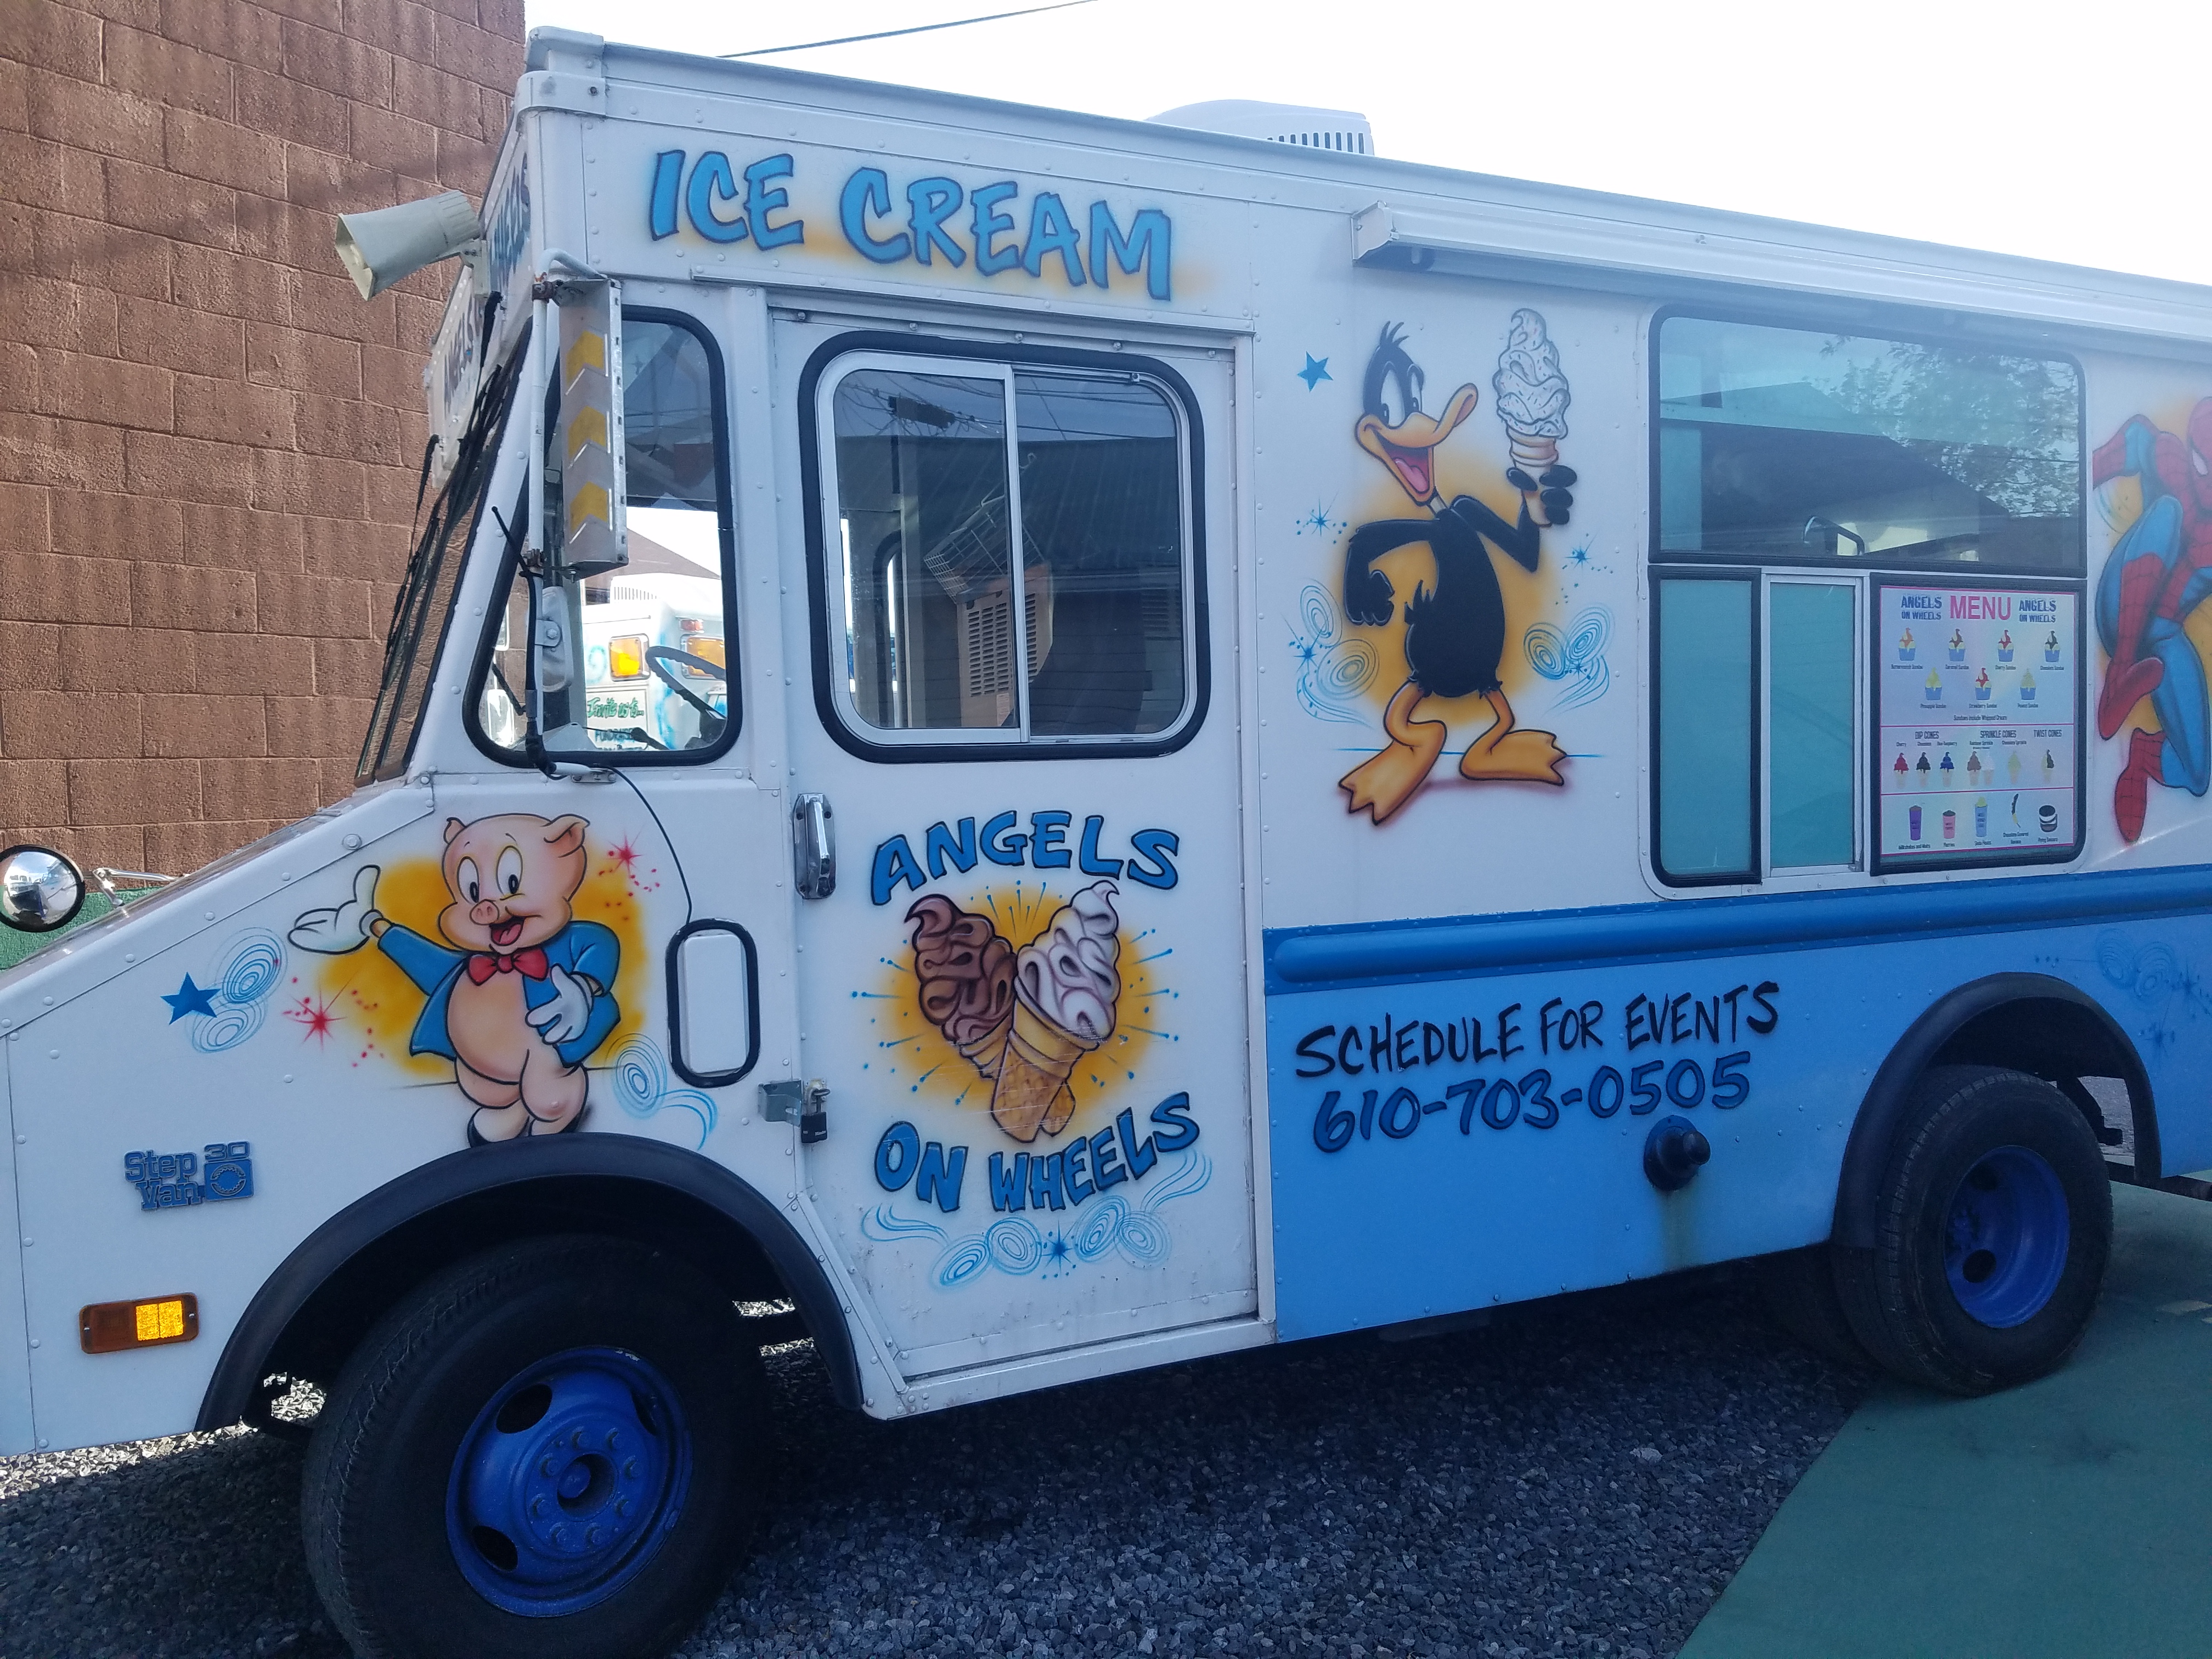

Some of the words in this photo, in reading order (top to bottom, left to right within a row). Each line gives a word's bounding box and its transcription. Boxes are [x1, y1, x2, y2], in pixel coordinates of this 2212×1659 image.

[650, 149, 805, 251] ICE
[839, 166, 1172, 301] CREAM
[1901, 595, 1942, 608] ANGELS
[1912, 611, 1942, 620] WHEELS
[1950, 595, 2011, 620] MENU
[2019, 599, 2057, 612] ANGELS
[870, 810, 1180, 906] ANGELS
[1295, 1002, 1524, 1079] SCHEDULE
[1540, 996, 1604, 1055] FOR
[1624, 980, 1780, 1051] EVENTS
[1313, 1050, 1751, 1153] 610-703-0505
[124, 1149, 198, 1183] Step
[204, 1141, 250, 1162] 30
[874, 1120, 969, 1213] ON
[988, 1091, 1200, 1213] WHEELS
[135, 1179, 204, 1211] Van
